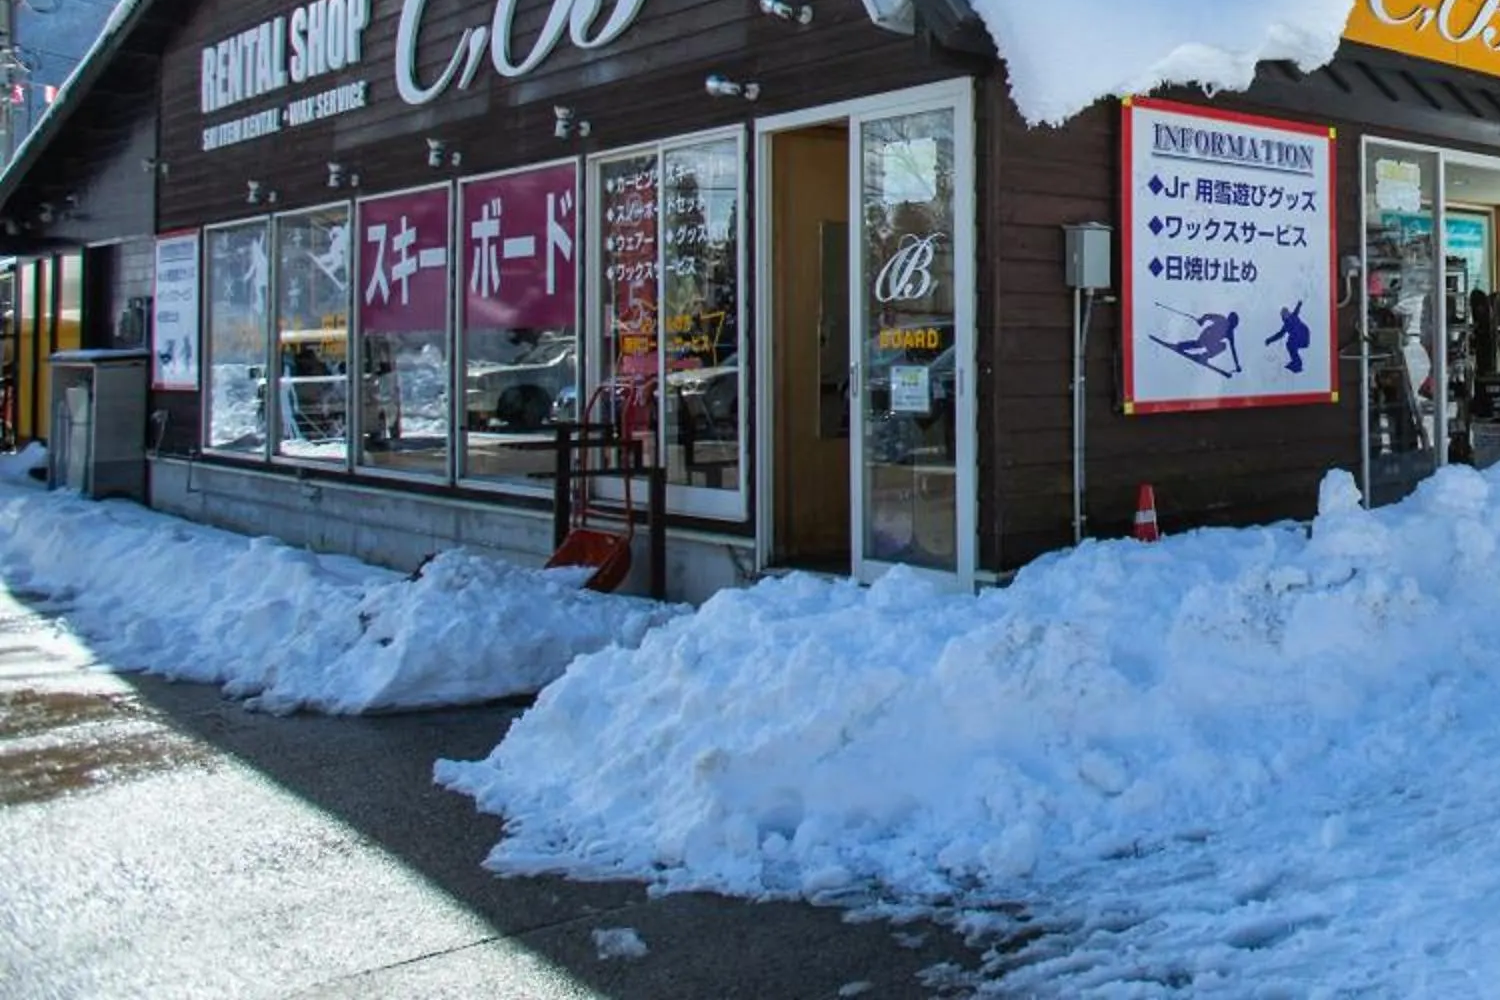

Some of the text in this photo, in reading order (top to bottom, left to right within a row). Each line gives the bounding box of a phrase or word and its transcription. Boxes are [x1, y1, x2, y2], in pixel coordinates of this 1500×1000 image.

[201, 15, 288, 114] RENTAL
[316, 80, 366, 119] SERVICE
[1151, 122, 1314, 169] INFORMATION
[1165, 176, 1317, 212] Jr 用雪遊びグッズ
[365, 189, 574, 306] スキー ボード
[1165, 216, 1309, 248] ワックスサービス
[1165, 255, 1258, 283] 日焼け止め
[879, 327, 940, 349] BOARD
